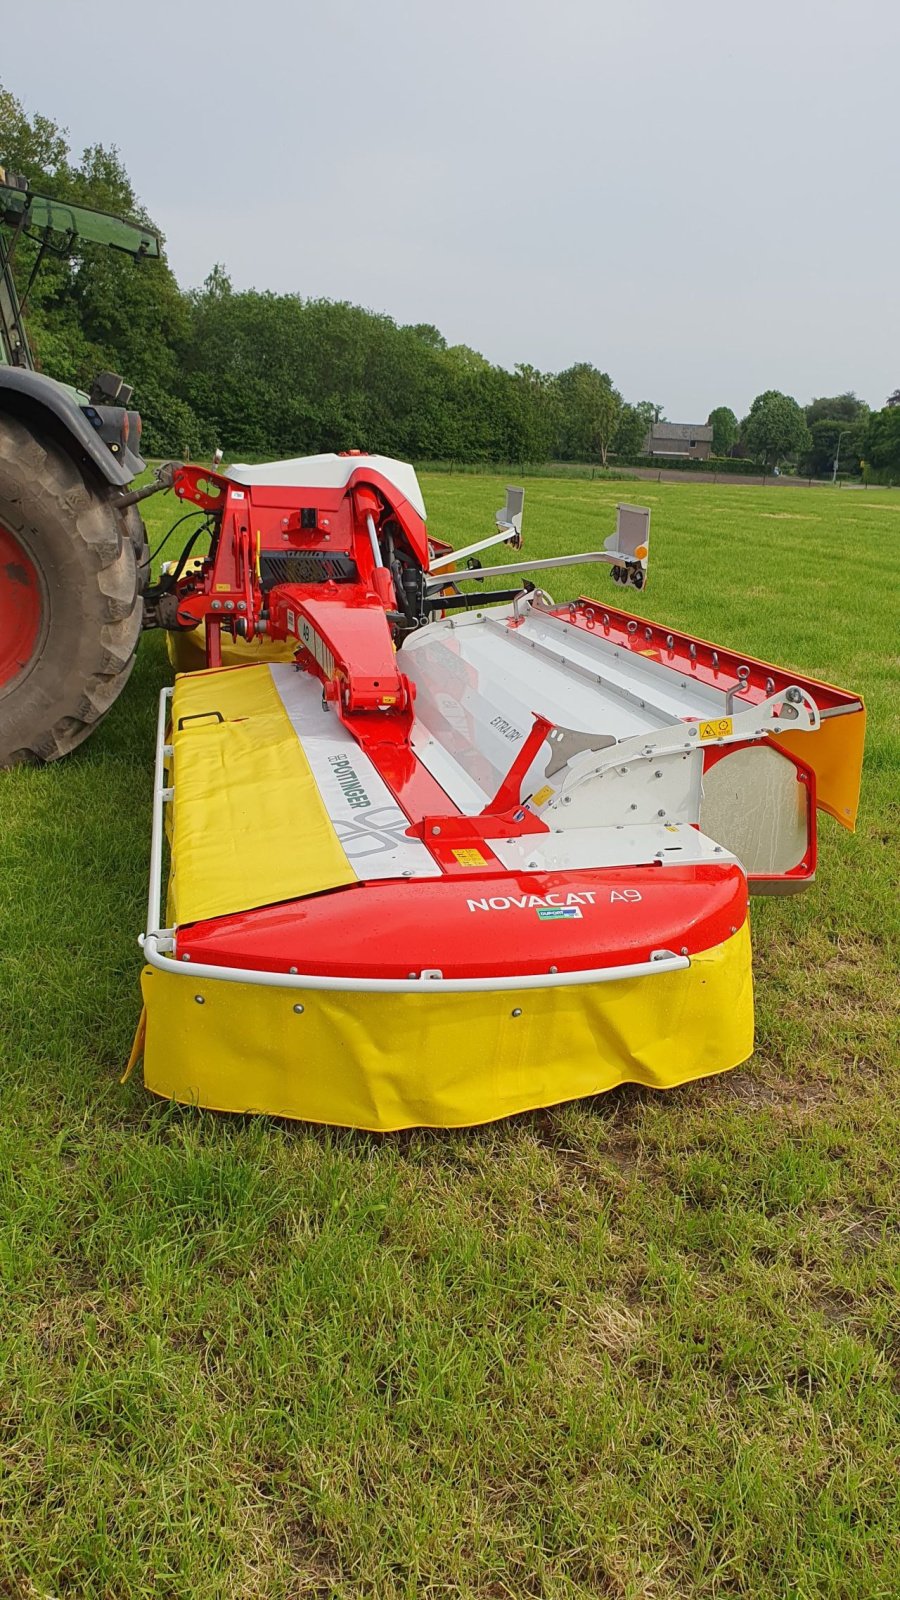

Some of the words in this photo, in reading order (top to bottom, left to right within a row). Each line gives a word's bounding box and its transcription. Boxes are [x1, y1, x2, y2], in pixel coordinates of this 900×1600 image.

[490, 716, 512, 735] EXTRA
[505, 728, 523, 743] DRY
[466, 891, 596, 912] NOVACAT
[610, 889, 642, 903] A9
